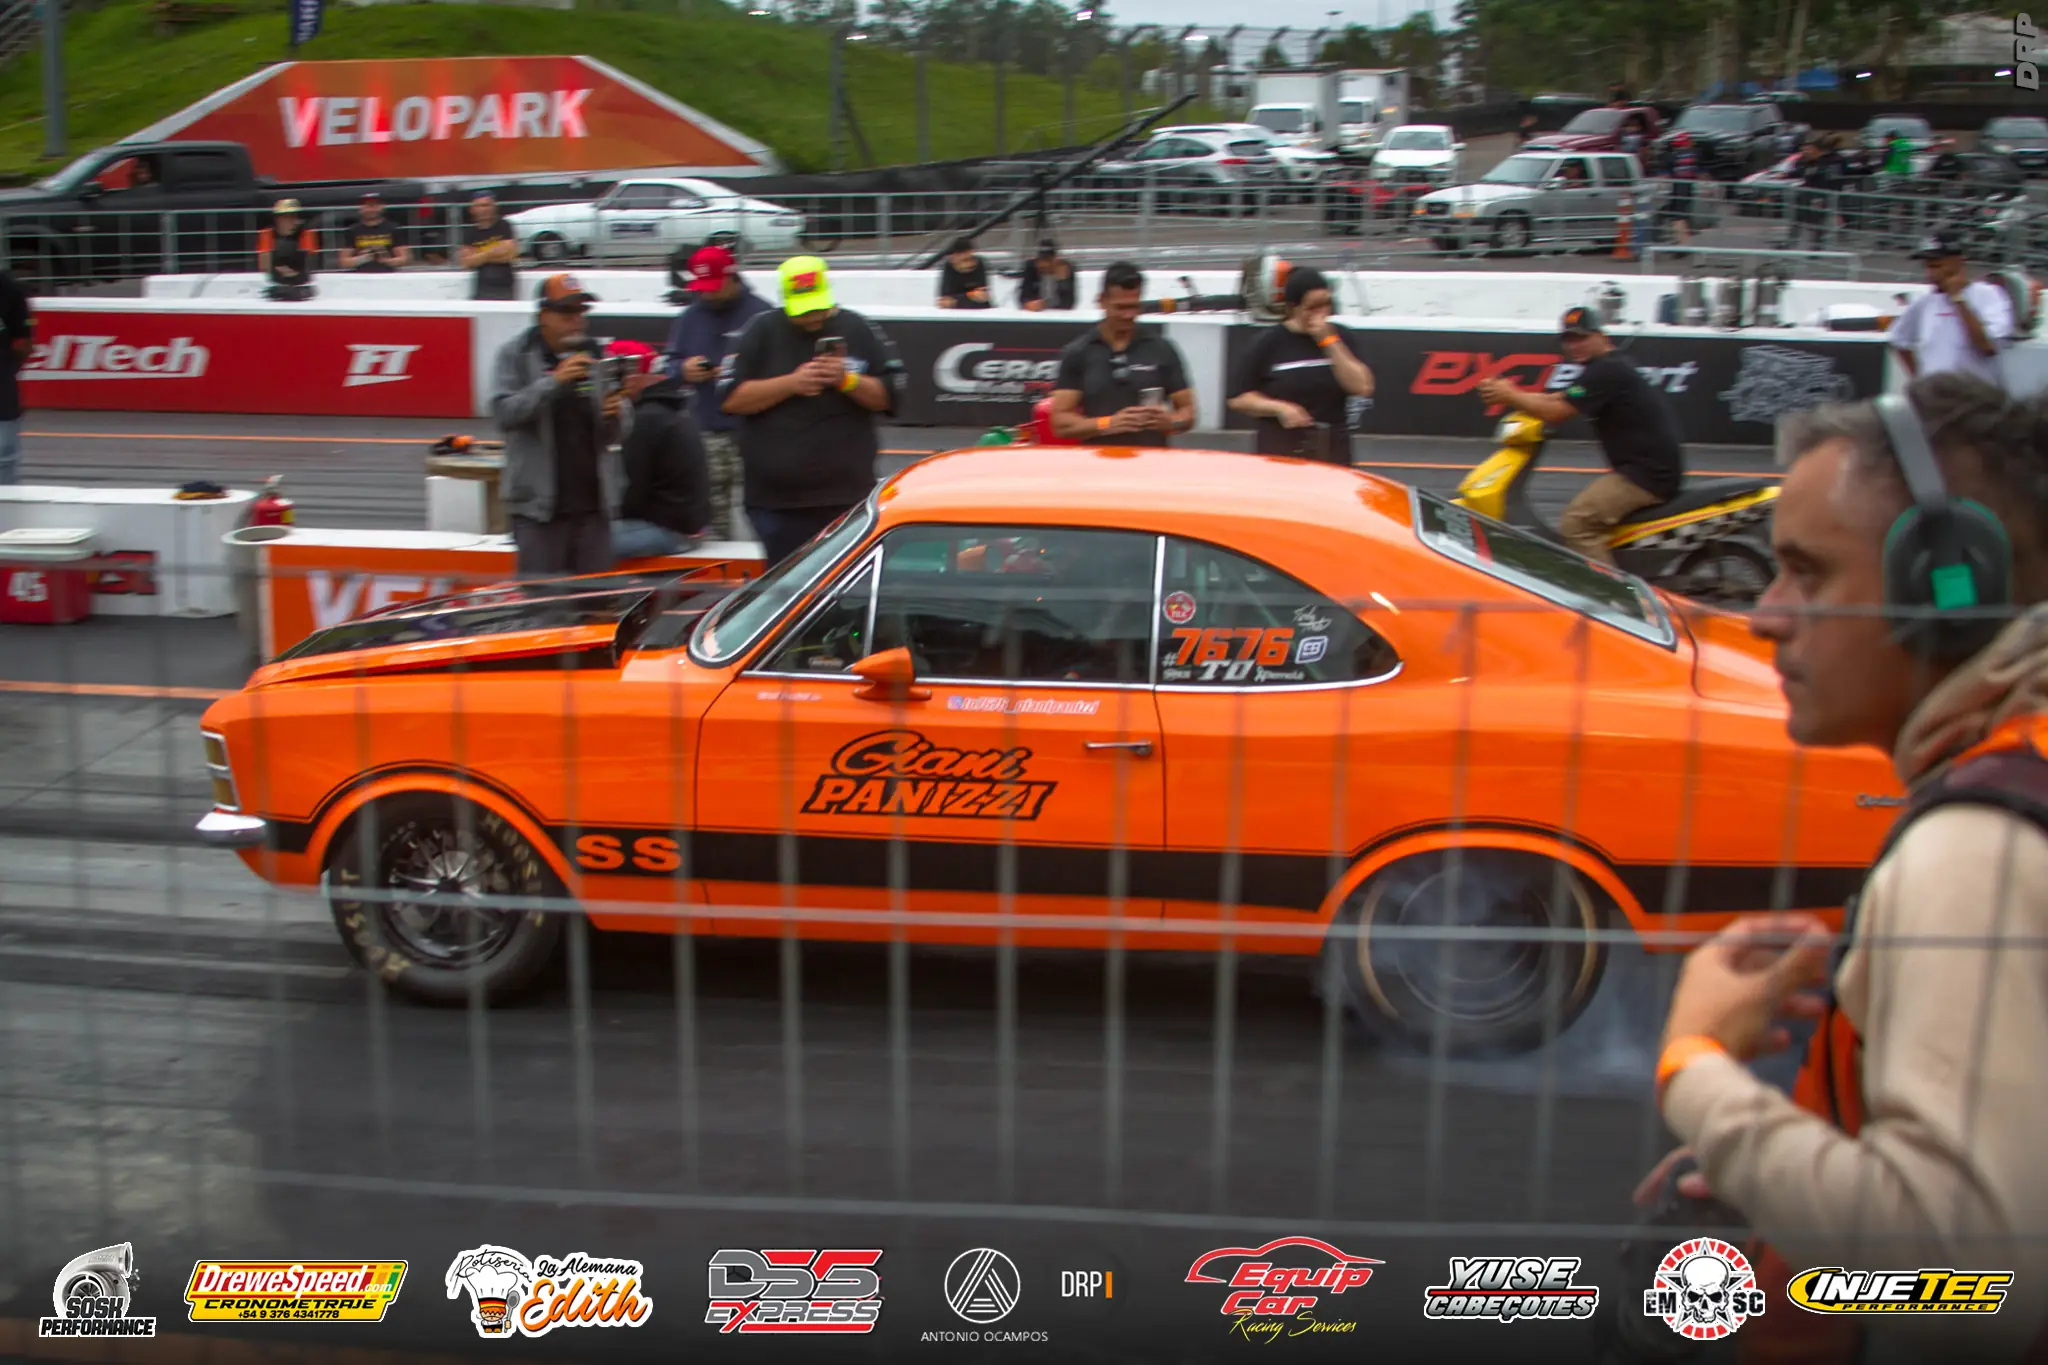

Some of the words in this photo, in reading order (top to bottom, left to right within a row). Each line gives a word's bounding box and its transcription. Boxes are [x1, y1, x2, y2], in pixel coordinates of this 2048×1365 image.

[277, 88, 594, 148] VELOPARK
[22, 335, 210, 378] elTech
[831, 728, 1033, 780] Giani
[800, 774, 1058, 822] PANIZZI
[575, 834, 682, 872] SS
